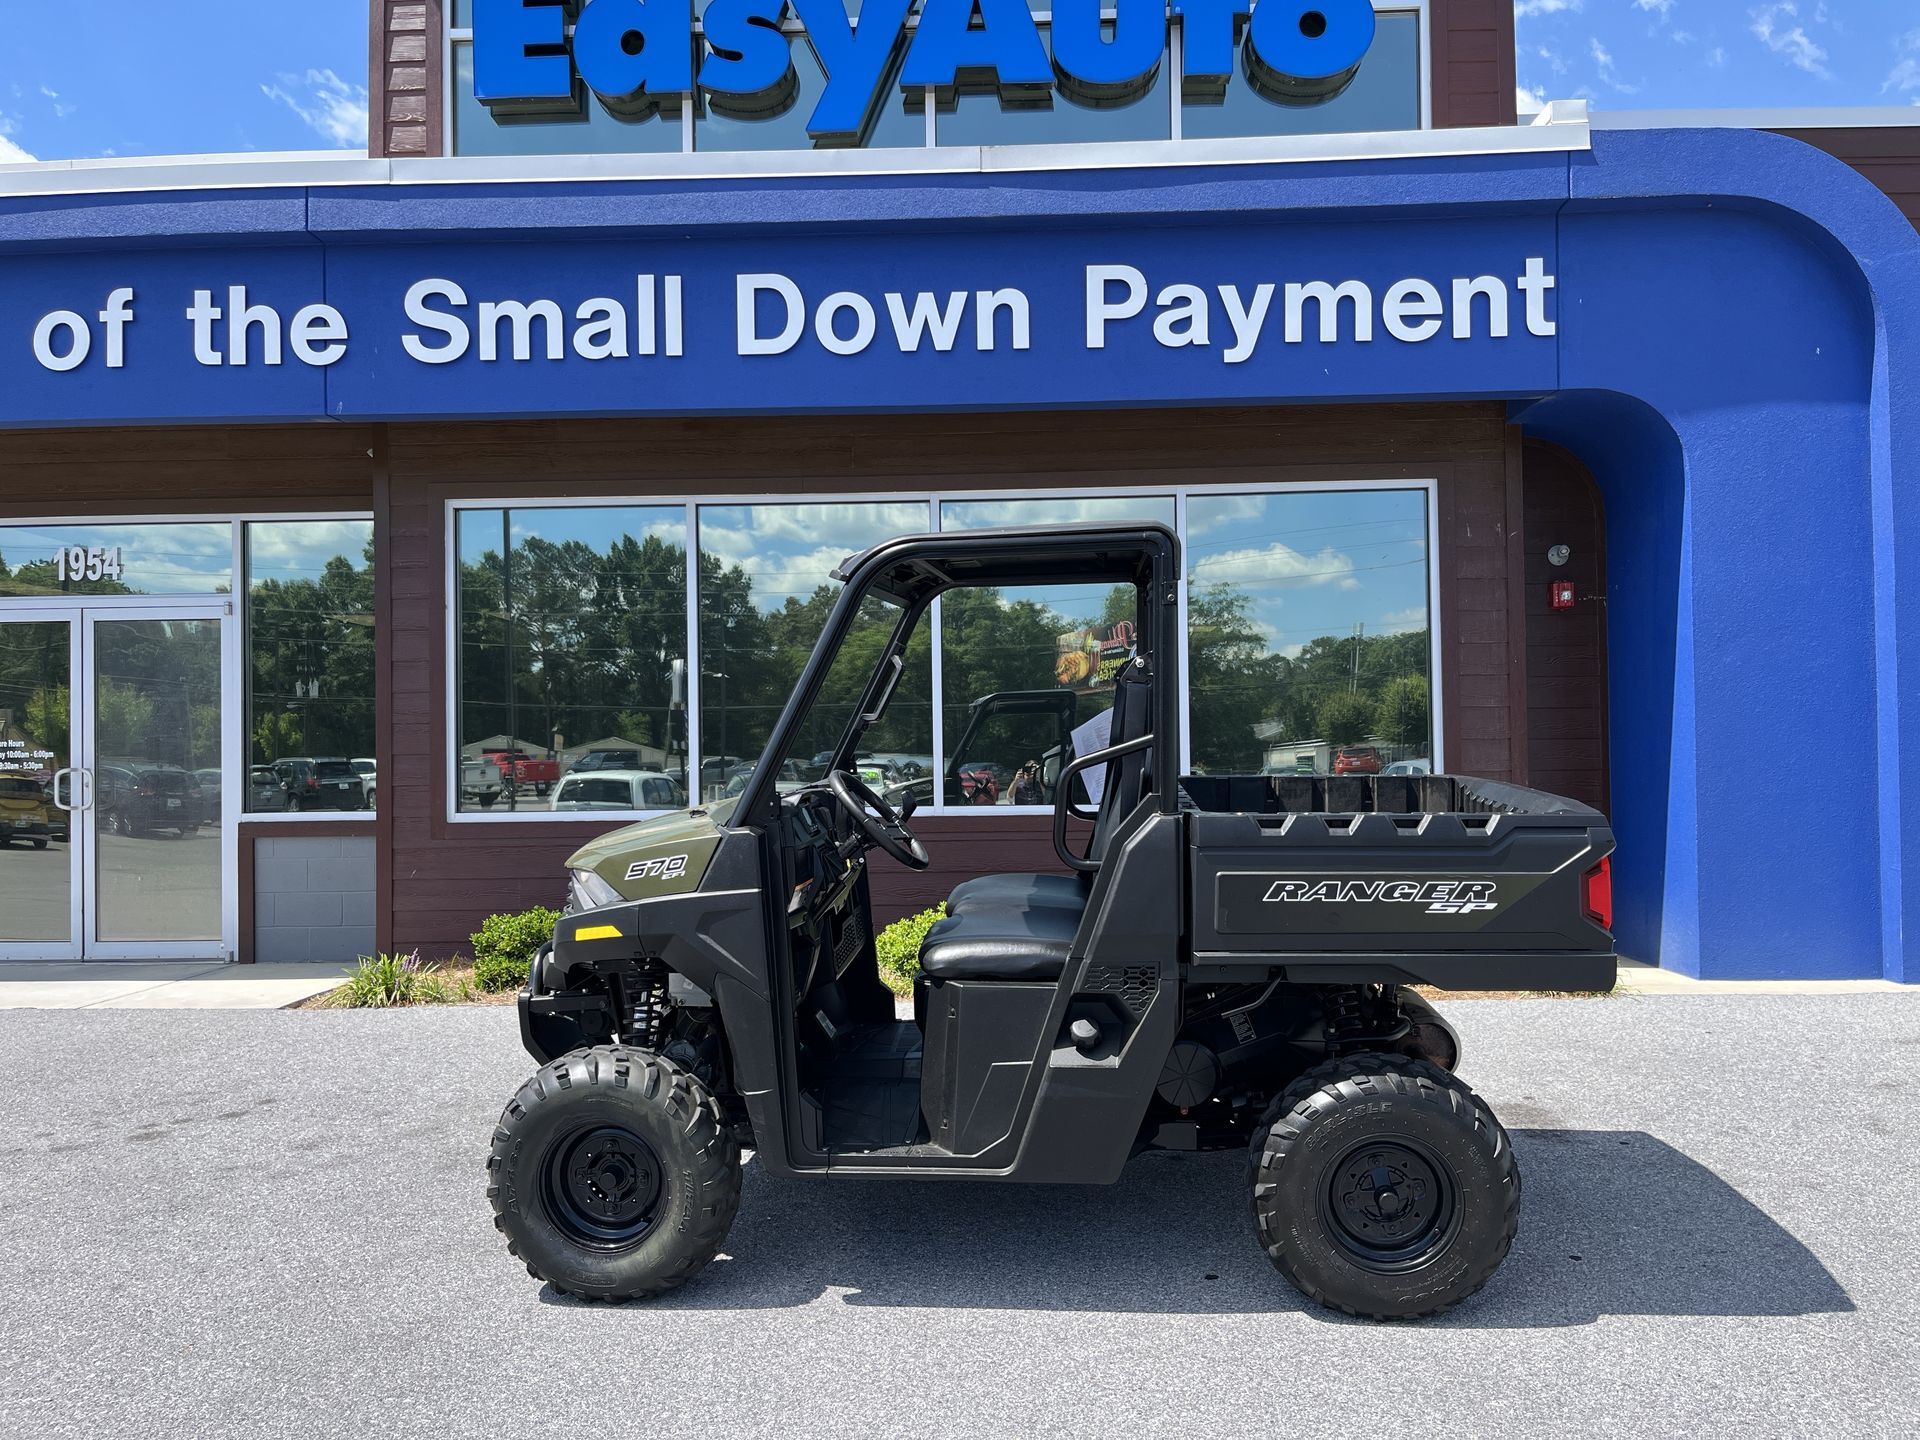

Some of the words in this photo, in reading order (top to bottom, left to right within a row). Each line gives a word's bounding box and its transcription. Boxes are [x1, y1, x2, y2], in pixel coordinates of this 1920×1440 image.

[33, 287, 134, 371] of
[187, 285, 348, 367] the
[401, 273, 683, 364] Small
[736, 273, 1030, 356] Down
[1086, 257, 1556, 363] Payment
[53, 546, 121, 581] 1954
[33, 751, 54, 759] 6:00pm
[624, 854, 689, 880] 570
[661, 870, 686, 880] EFI
[1262, 880, 1497, 902] RANGER
[1424, 902, 1498, 914] SP
